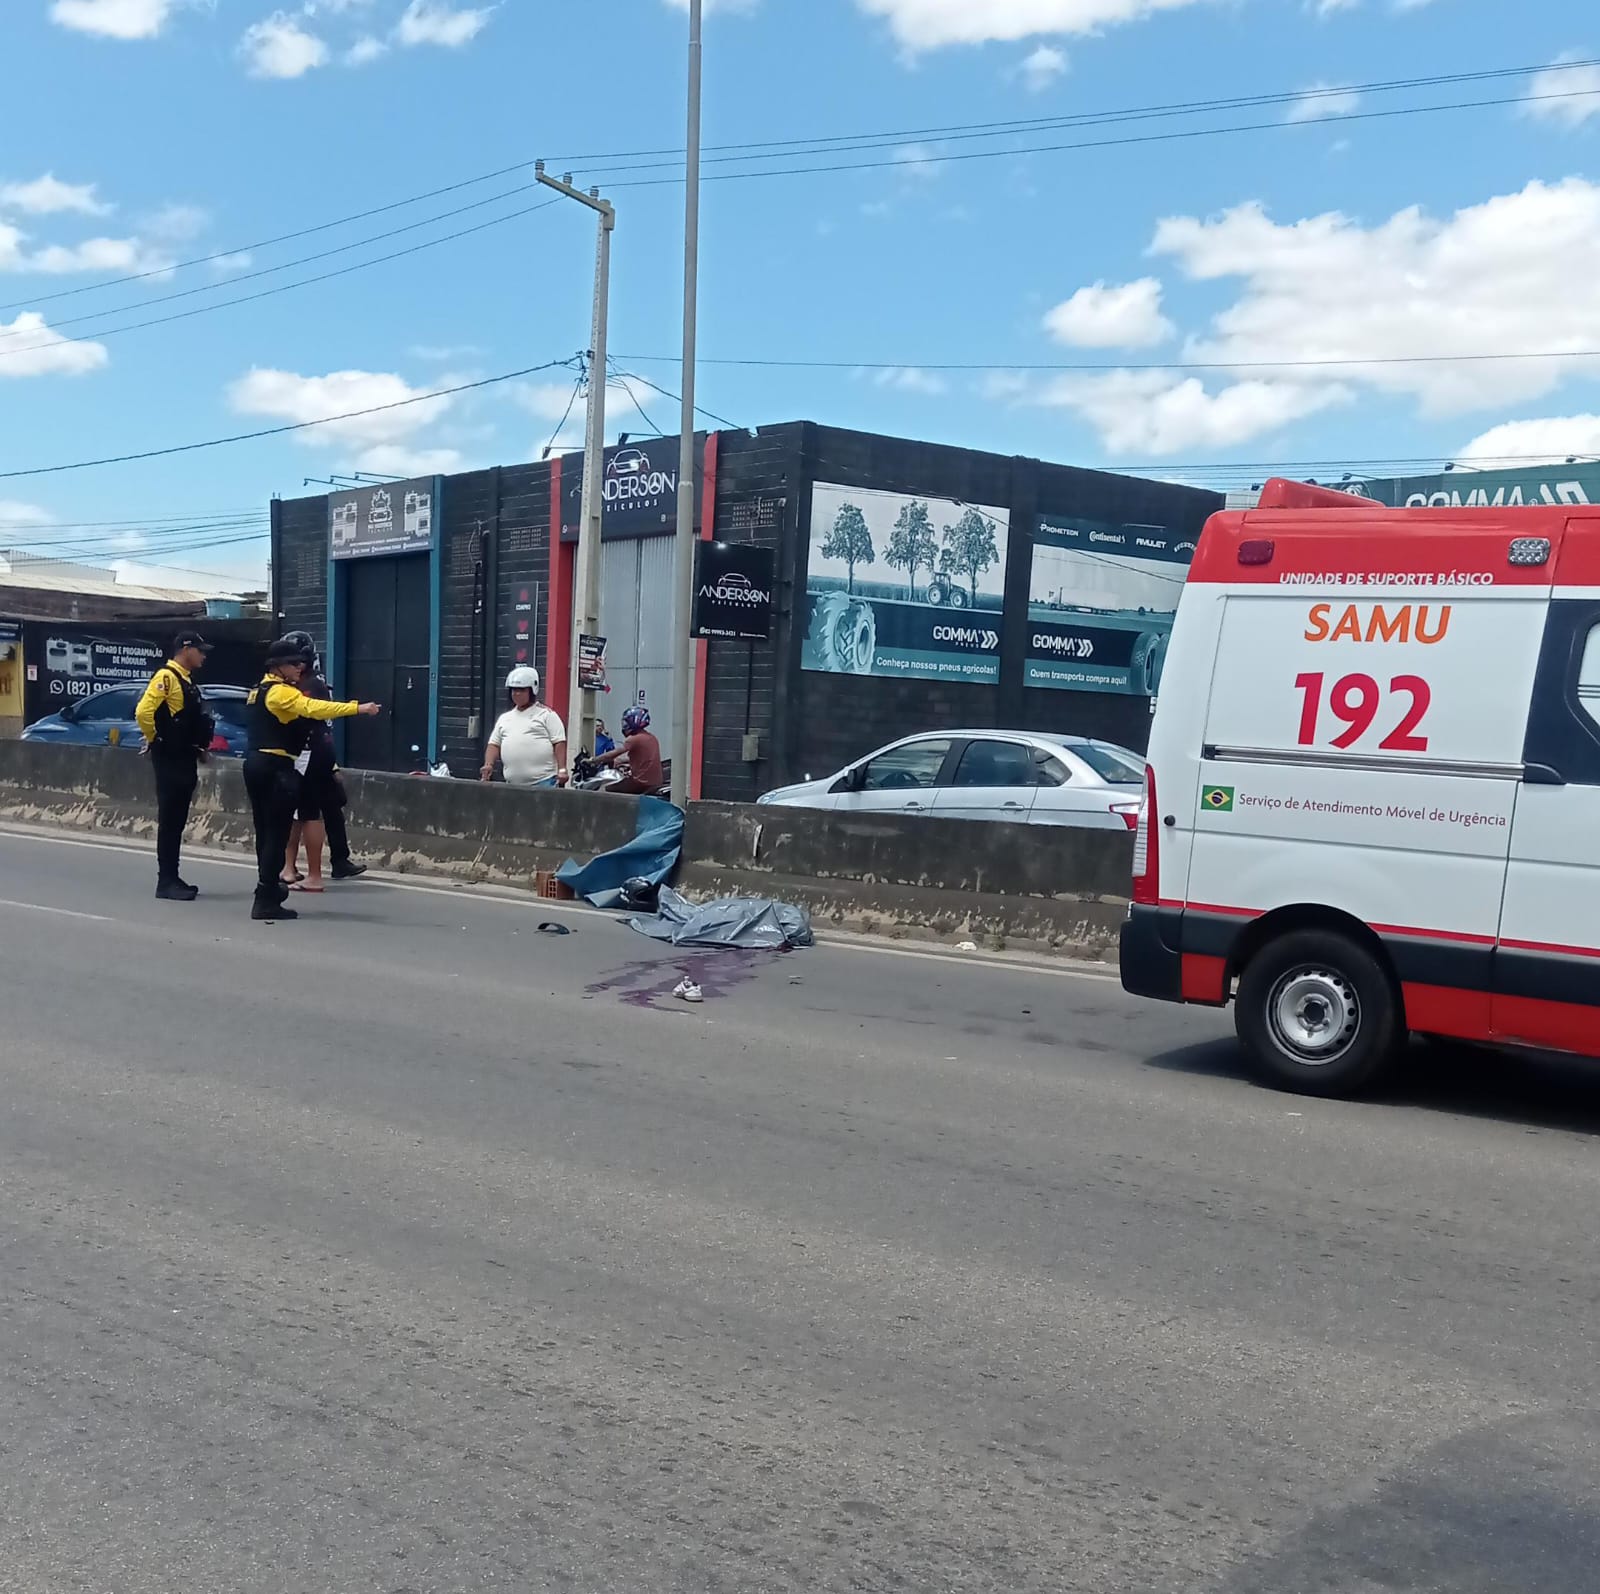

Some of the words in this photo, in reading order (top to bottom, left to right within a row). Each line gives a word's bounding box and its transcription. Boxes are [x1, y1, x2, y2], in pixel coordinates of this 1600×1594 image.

[601, 470, 676, 500] NDERSON
[1279, 572, 1343, 585] UNIDADE
[1345, 573, 1364, 585] DE
[1367, 573, 1434, 585] SUPORTE
[1437, 570, 1494, 585] BÁSICO
[699, 584, 770, 603] ANDERSON
[1304, 603, 1452, 644] SAMU
[933, 625, 979, 643] GOMMA
[1032, 634, 1075, 650] GOMMA
[112, 656, 120, 664] DE
[876, 656, 909, 669] Conheça
[910, 660, 937, 671] nossos
[939, 663, 961, 672] pneus
[1030, 668, 1050, 678] Quem
[1051, 671, 1085, 682] transporta
[1086, 674, 1110, 684] compra
[67, 680, 91, 696] (82)
[1294, 671, 1432, 753] 192
[1239, 793, 1282, 810] Serviço
[1284, 796, 1299, 810] de
[1302, 799, 1383, 817] Atendimento
[1386, 805, 1425, 821] Móvel
[1429, 808, 1446, 822] de
[1448, 811, 1507, 828] Urgência
